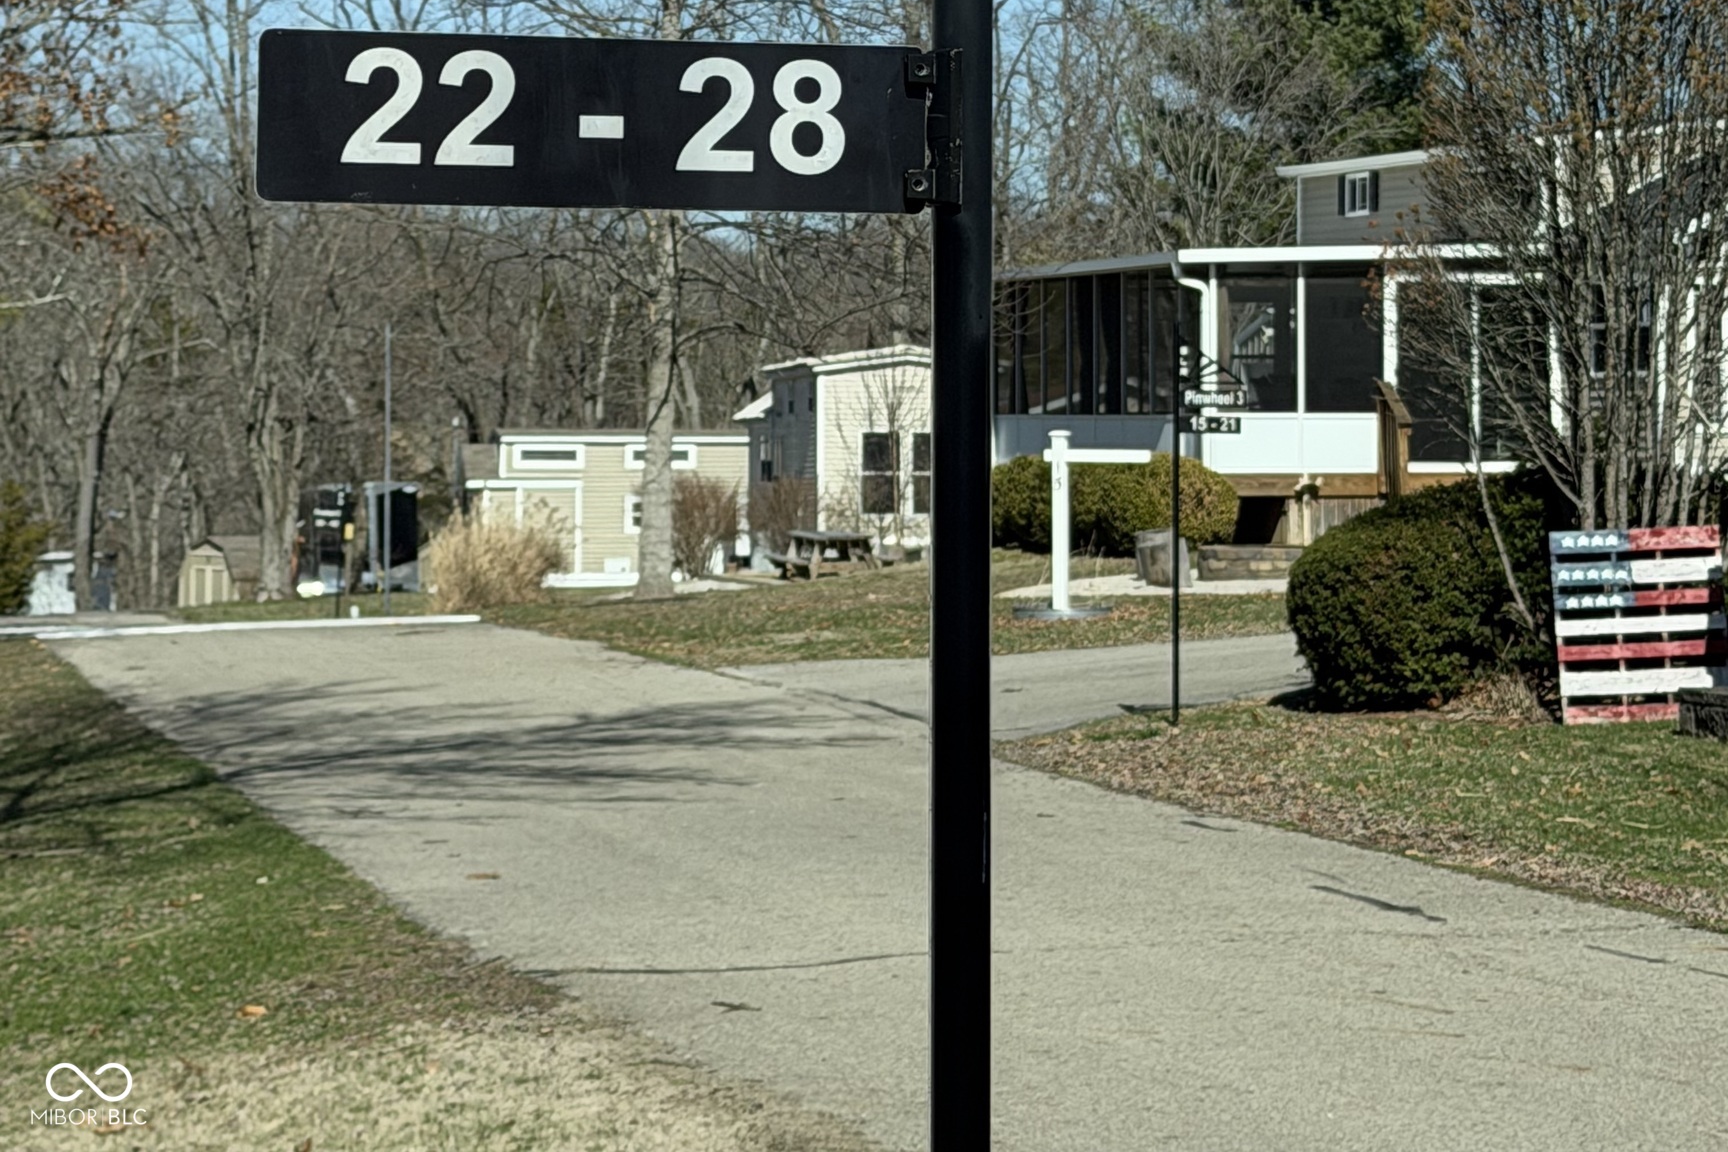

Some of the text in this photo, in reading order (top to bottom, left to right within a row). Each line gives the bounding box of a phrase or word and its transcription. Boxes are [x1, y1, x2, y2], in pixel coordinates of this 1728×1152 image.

[340, 46, 846, 176] 22 - 28
[1184, 389, 1244, 405] Pinwheel 3
[1190, 415, 1207, 431] 15
[1219, 417, 1236, 431] 21
